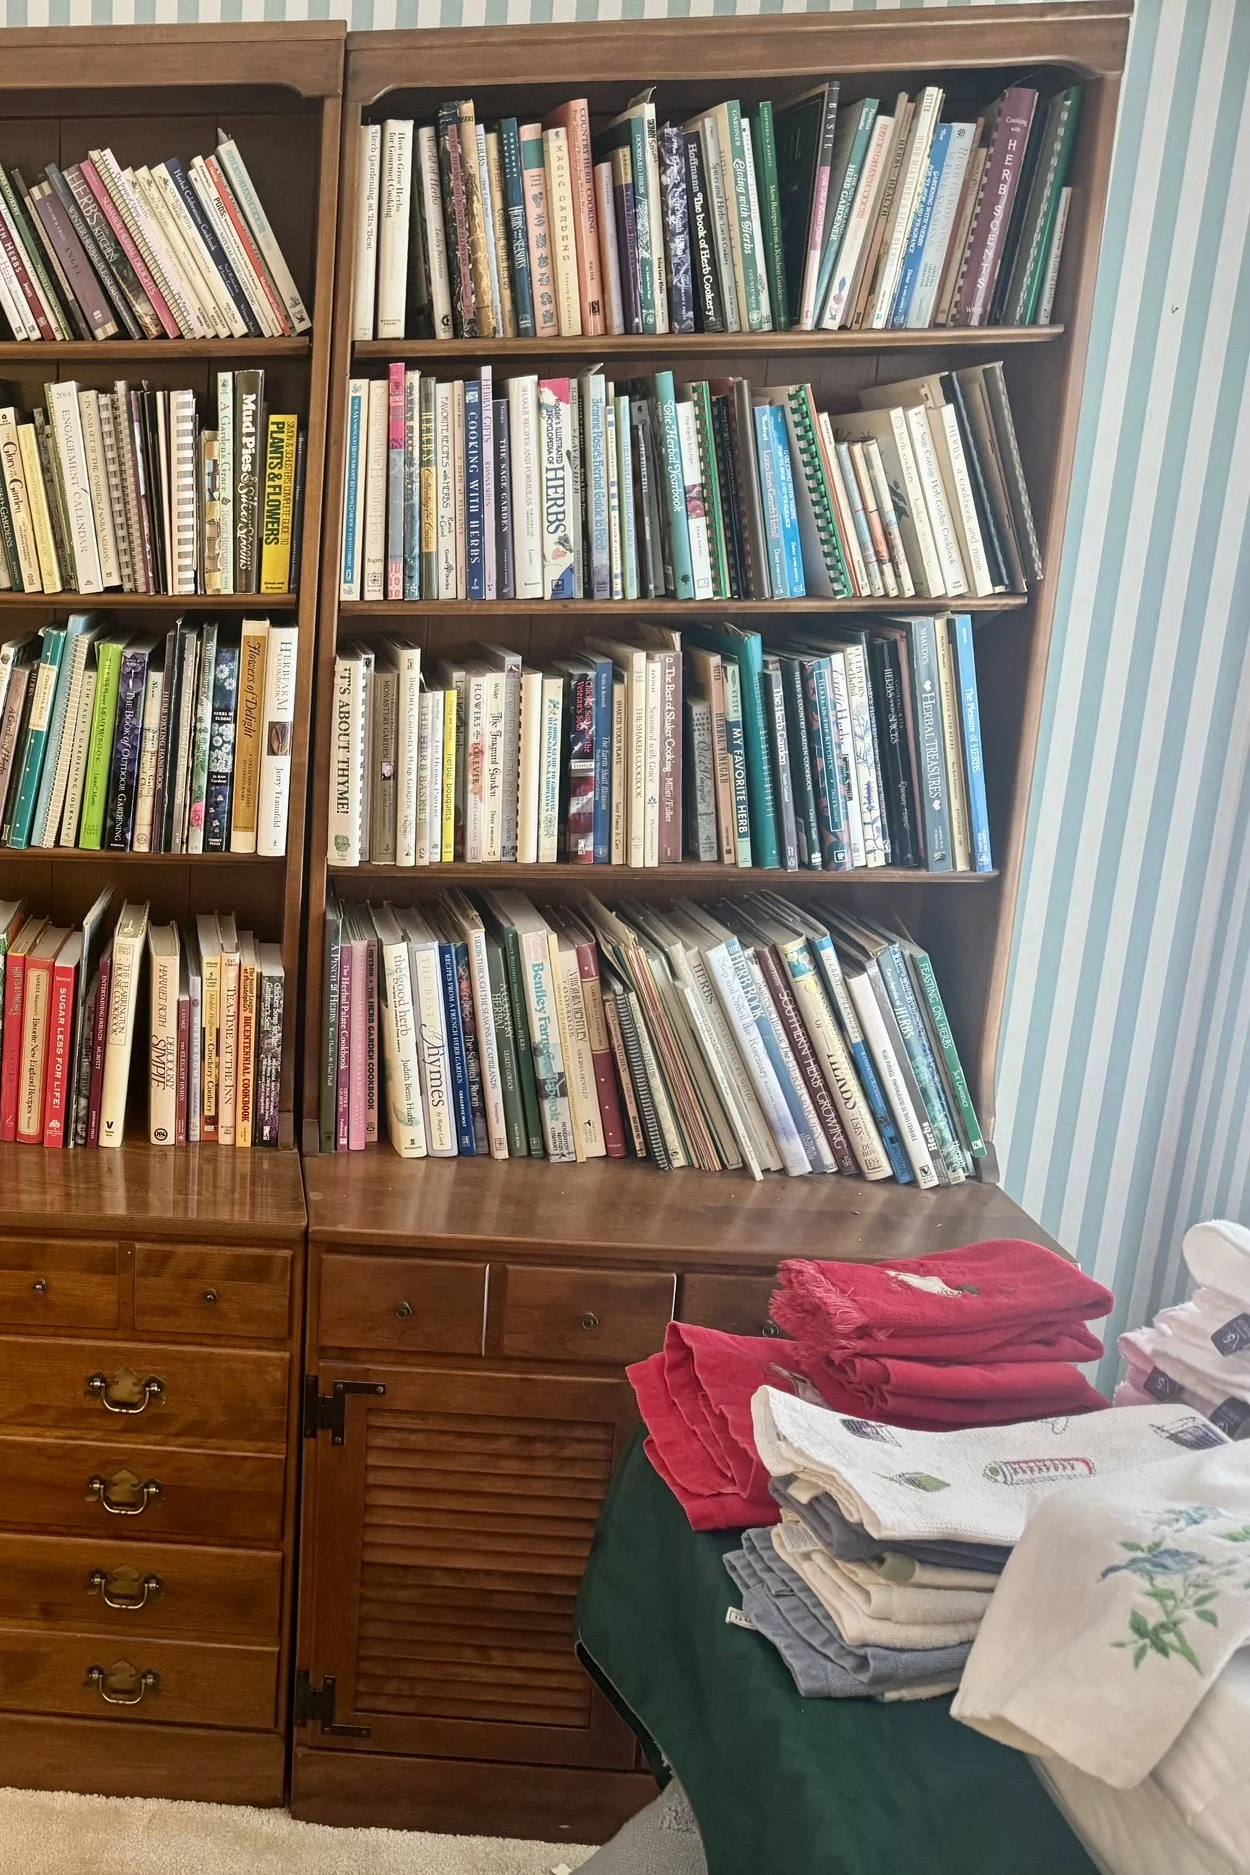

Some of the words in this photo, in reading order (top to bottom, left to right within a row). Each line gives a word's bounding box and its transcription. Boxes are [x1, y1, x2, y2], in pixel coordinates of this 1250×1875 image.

[369, 129, 378, 153] Herb
[397, 132, 405, 151] How
[397, 153, 404, 161] to
[368, 155, 376, 200] Gardening
[387, 145, 396, 182] Gourmet
[688, 143, 700, 193] Hoffmann
[734, 158, 747, 194] Living
[369, 203, 375, 211] at
[386, 184, 395, 218] Cooking
[396, 187, 404, 212] Herbs
[694, 193, 704, 211] The
[739, 196, 750, 218] with
[366, 229, 374, 250] Best
[696, 213, 707, 238] book
[741, 220, 754, 254] Herbs
[4, 243, 22, 273] HERBS
[699, 239, 709, 248] of
[700, 250, 711, 274] Herb
[703, 276, 715, 316] Cookery
[242, 394, 256, 433] Mud
[663, 400, 673, 423] The
[242, 436, 255, 471] Pies
[270, 422, 284, 470] PLANTS
[468, 412, 478, 473] COOKING
[666, 426, 678, 463] Herbal
[62, 409, 79, 486] ENGAGEMENT
[73, 491, 88, 552] CALENDAR
[269, 472, 280, 481] &
[668, 466, 684, 512] Yearbook
[238, 484, 257, 524] Silver
[470, 480, 479, 512] WITH
[545, 466, 566, 535] HERBS
[265, 485, 280, 545] FLOWERS
[238, 524, 254, 570] Spoons
[470, 521, 480, 564] HERBS
[246, 641, 261, 683] Flowers
[243, 685, 259, 695] of
[243, 697, 257, 738] Delight
[338, 701, 350, 752] ABOUT
[922, 693, 935, 739] HERBAL
[733, 728, 743, 744] MY
[734, 750, 745, 801] FAVORITE
[925, 740, 941, 798] TREASURES
[336, 758, 349, 815] THYME!
[737, 806, 748, 833] HERB
[393, 955, 405, 973] the
[394, 976, 406, 1007] good
[920, 963, 938, 1003] FEASTING
[57, 987, 67, 1024] SUGAR
[225, 986, 236, 1041] TEA-TIME
[367, 1001, 375, 1024] HERB
[934, 1006, 942, 1020] ON
[55, 1027, 65, 1054] LESS
[398, 1011, 410, 1036] herb
[936, 1023, 952, 1049] HERBS
[225, 1044, 233, 1056] AT
[242, 1016, 252, 1077] BICENTENNIAL
[367, 1026, 375, 1060] GARDEN
[54, 1057, 63, 1078] FOR
[225, 1058, 233, 1082] THE
[780, 991, 811, 1053] SOUTHERN
[804, 1060, 822, 1088] HERB
[816, 1092, 840, 1148] GROWING
[53, 1081, 62, 1109] LIFE!
[224, 1085, 234, 1105] INN
[241, 1078, 250, 1122] COOKBOOK
[367, 1063, 375, 1110] COOKBOOK
